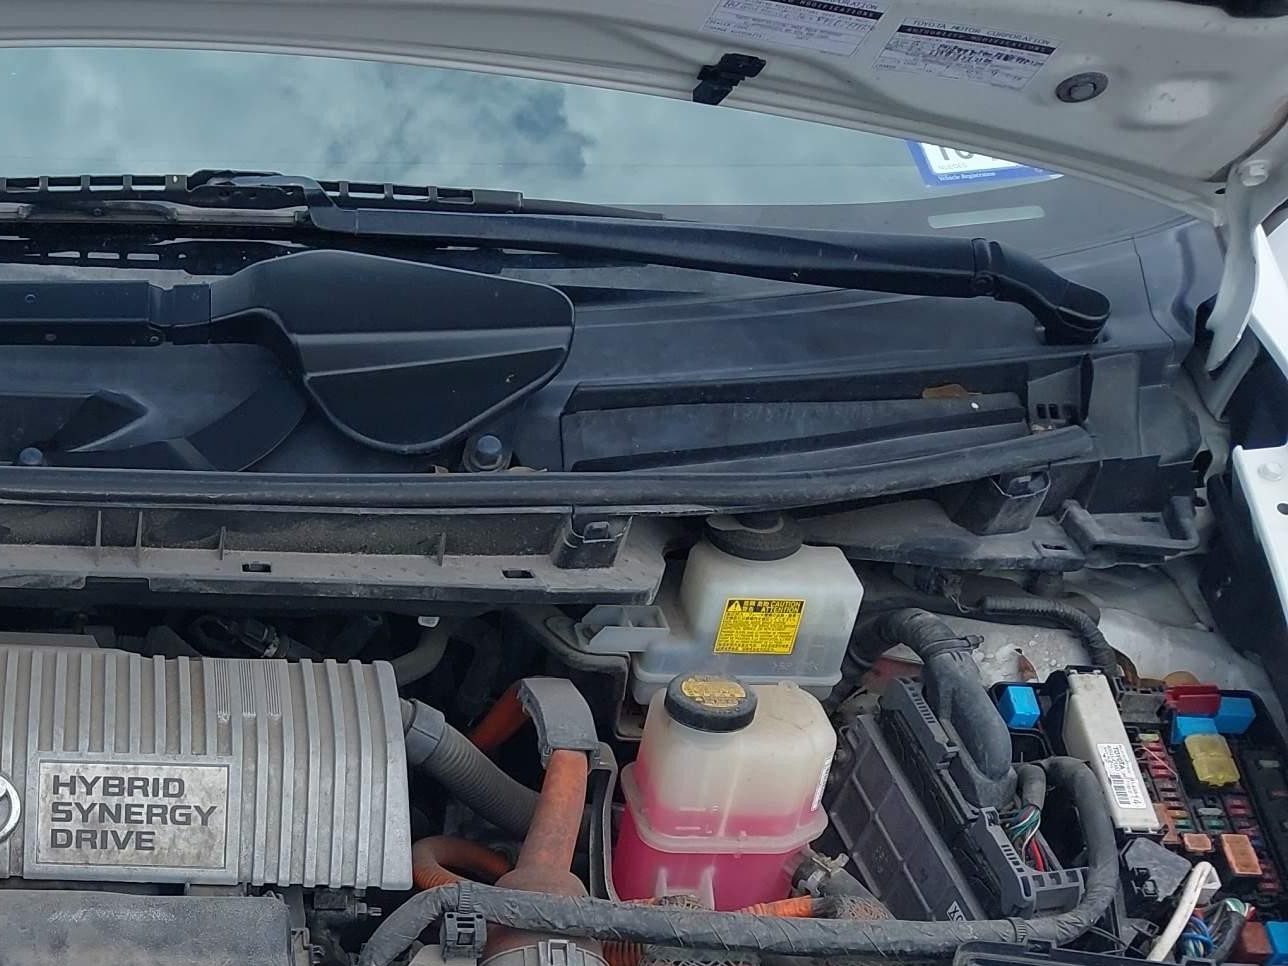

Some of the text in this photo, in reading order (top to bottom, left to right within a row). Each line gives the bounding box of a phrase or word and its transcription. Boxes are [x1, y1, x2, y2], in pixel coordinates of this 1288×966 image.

[913, 20, 1050, 46] TOYOTA MOTOR CORPORATION
[770, 600, 801, 608] CAUTION
[52, 774, 185, 799] HYBRID
[50, 801, 217, 827] SYNERGY
[49, 828, 157, 852] DRIVE
